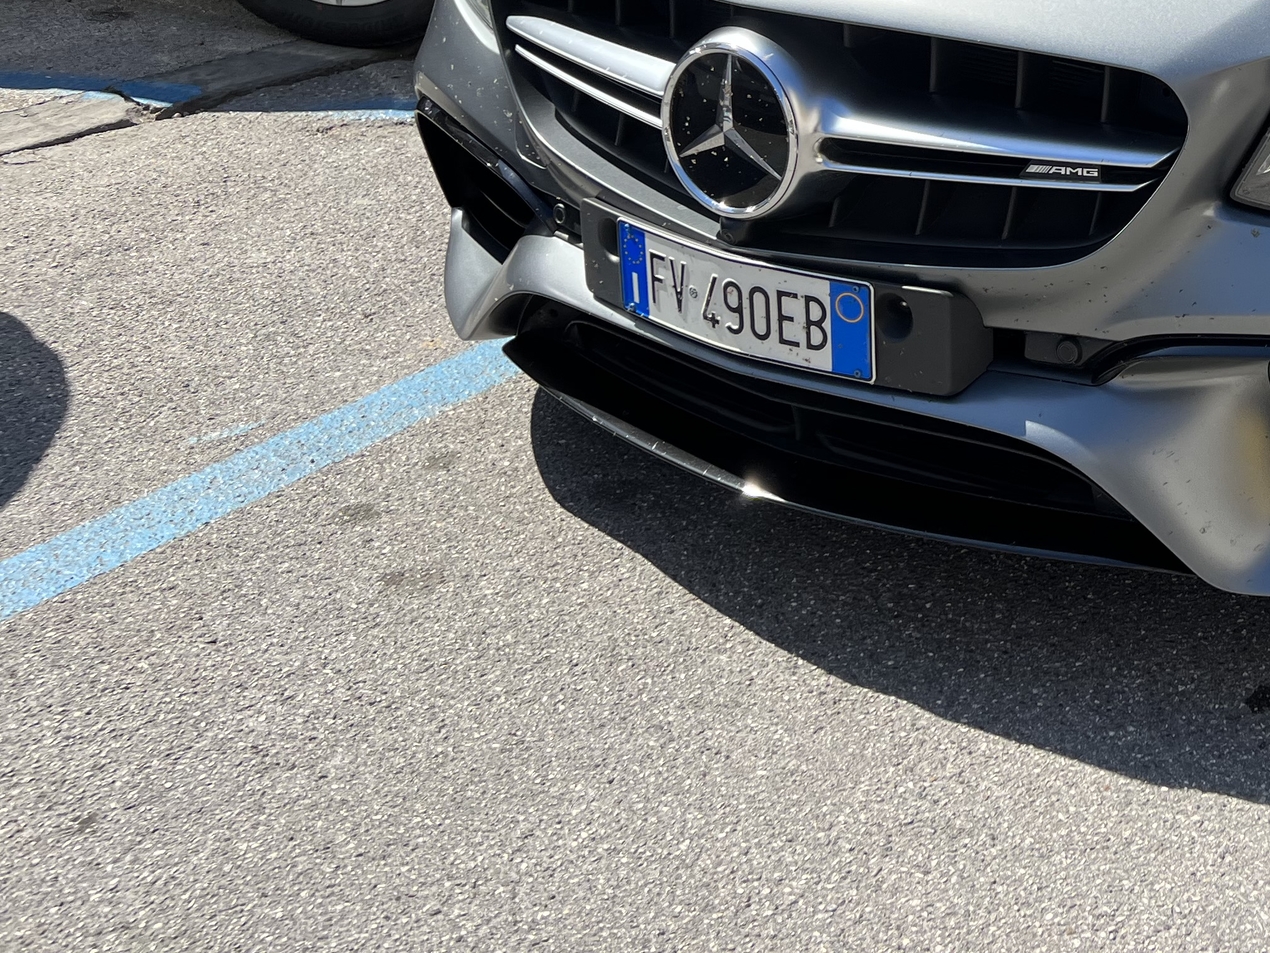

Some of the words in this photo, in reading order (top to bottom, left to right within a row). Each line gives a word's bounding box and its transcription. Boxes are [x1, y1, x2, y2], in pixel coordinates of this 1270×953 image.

[1048, 165, 1099, 177] AMG
[649, 250, 687, 313] FV
[702, 274, 828, 351] 490EB
